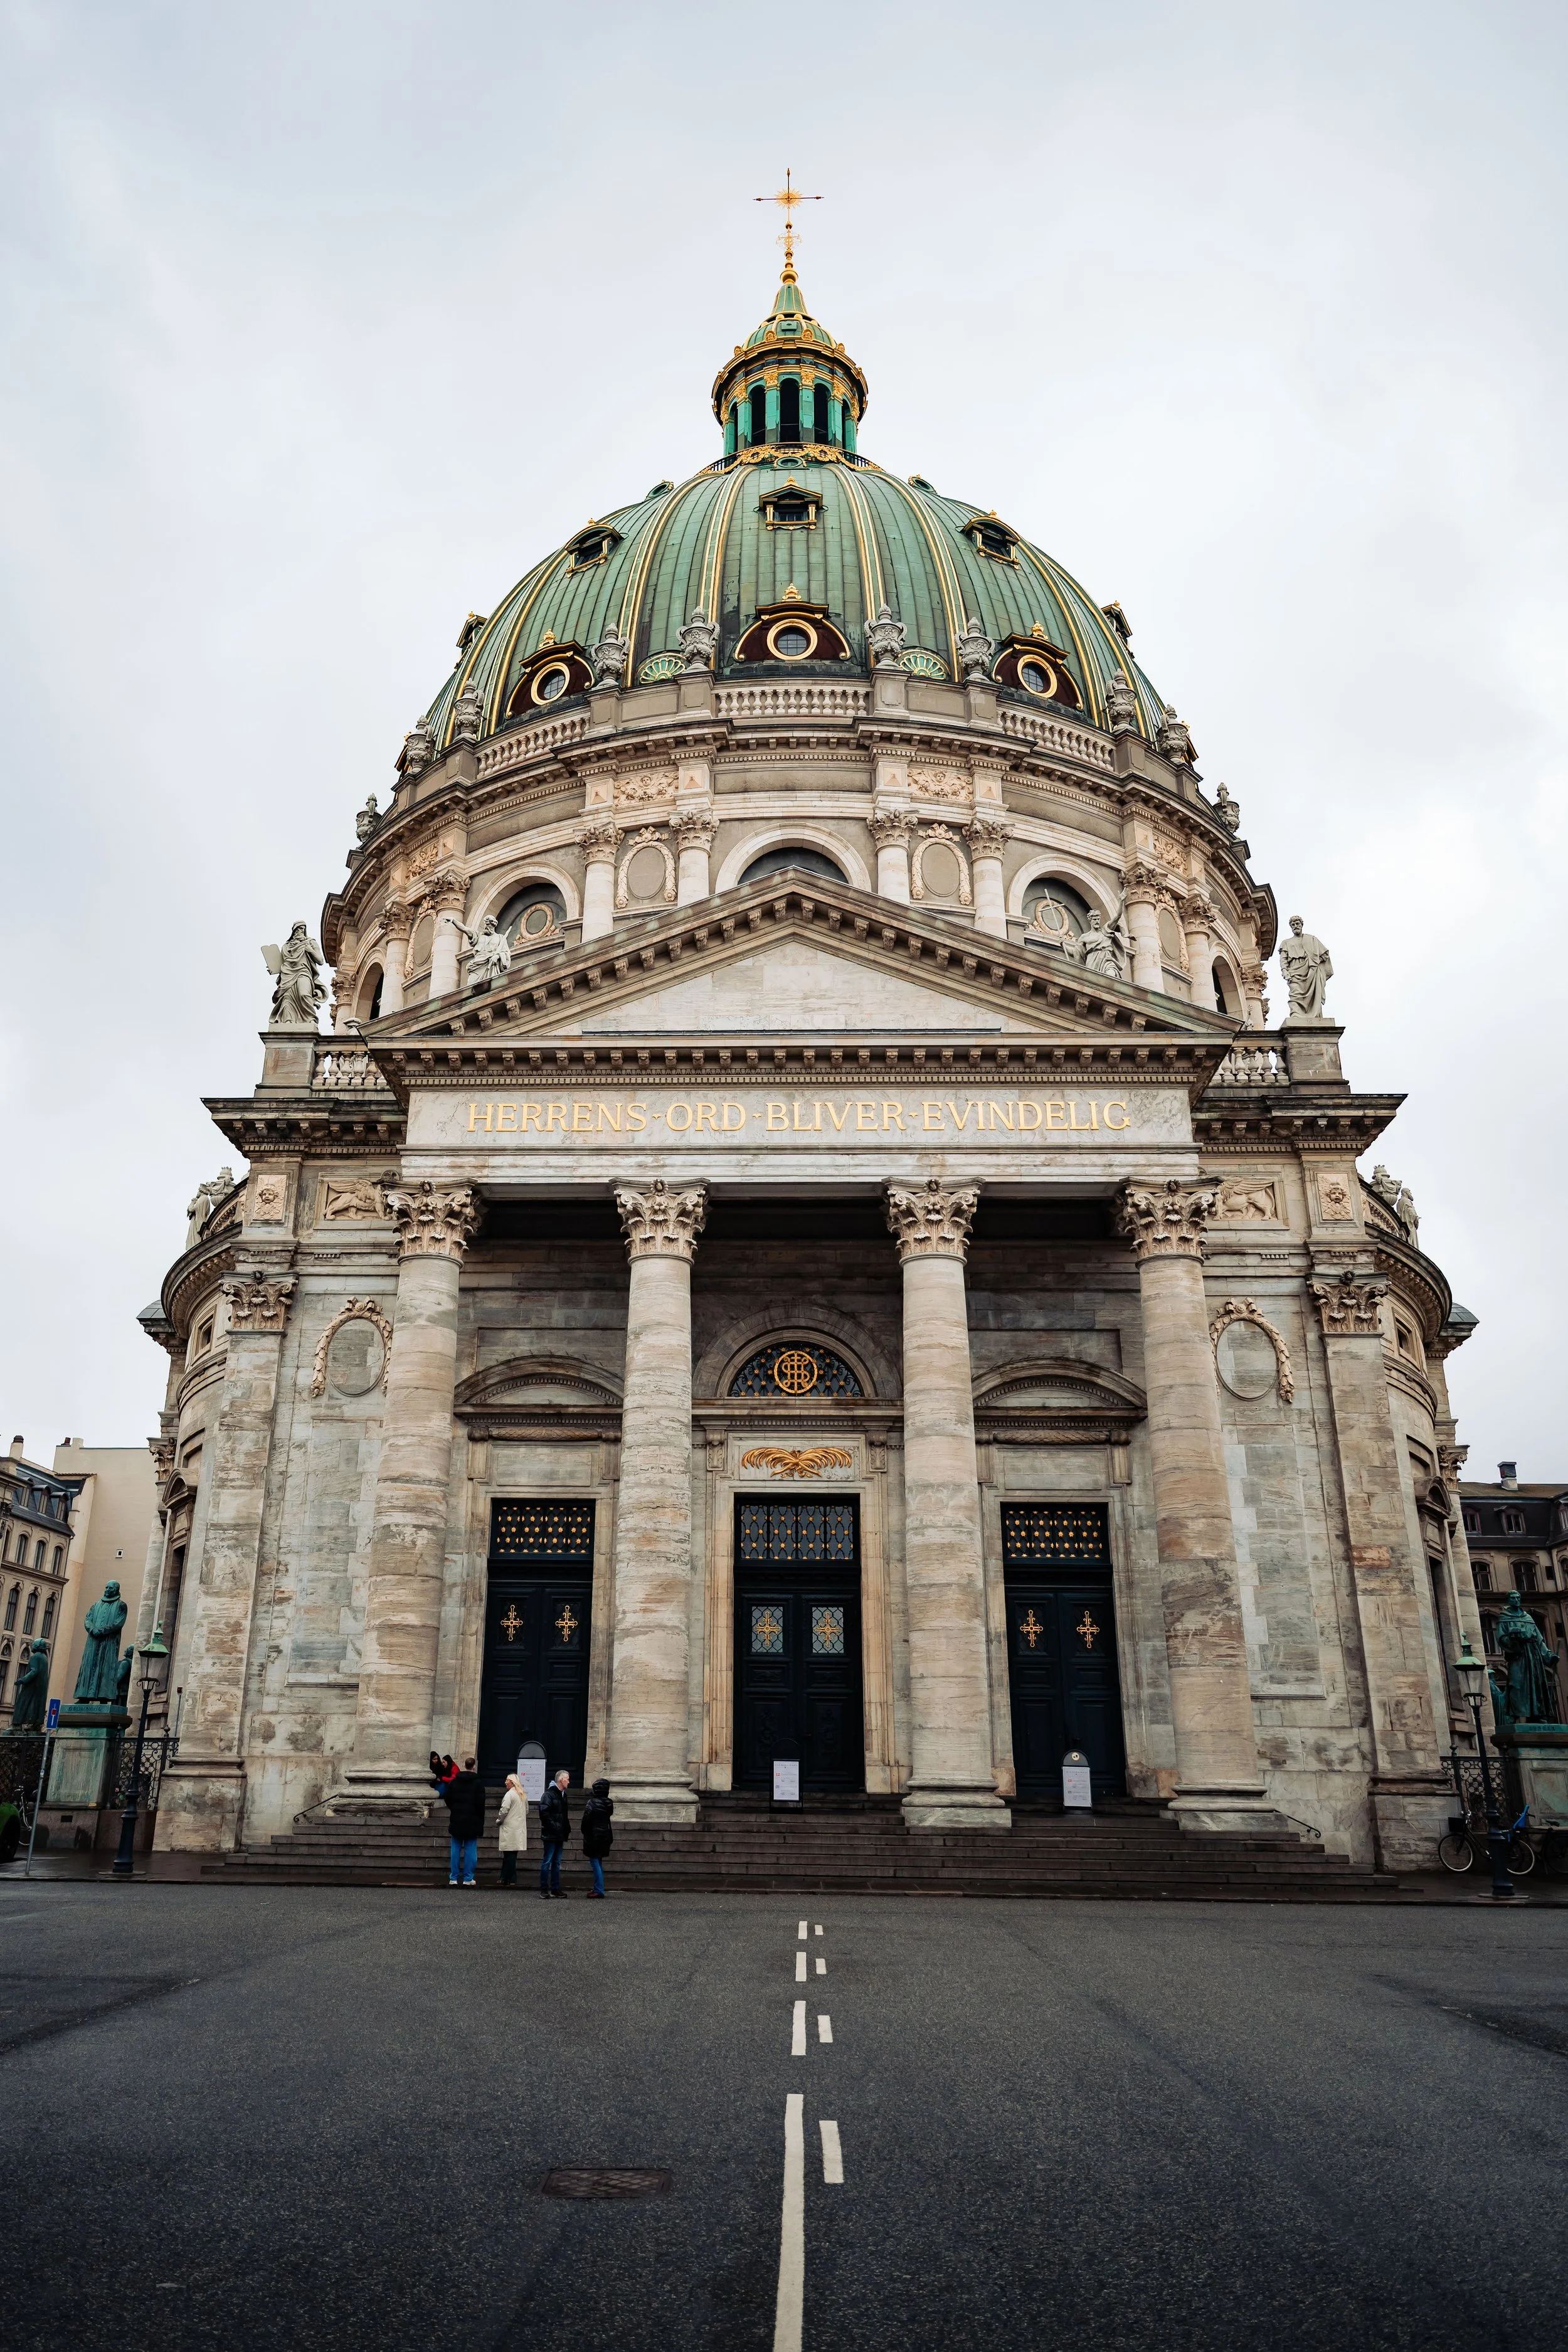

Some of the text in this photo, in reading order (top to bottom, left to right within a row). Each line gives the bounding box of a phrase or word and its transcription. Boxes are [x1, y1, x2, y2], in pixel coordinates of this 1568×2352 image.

[467, 1101, 1131, 1131] HERRENS ORD BLIVER EVINDELIG
